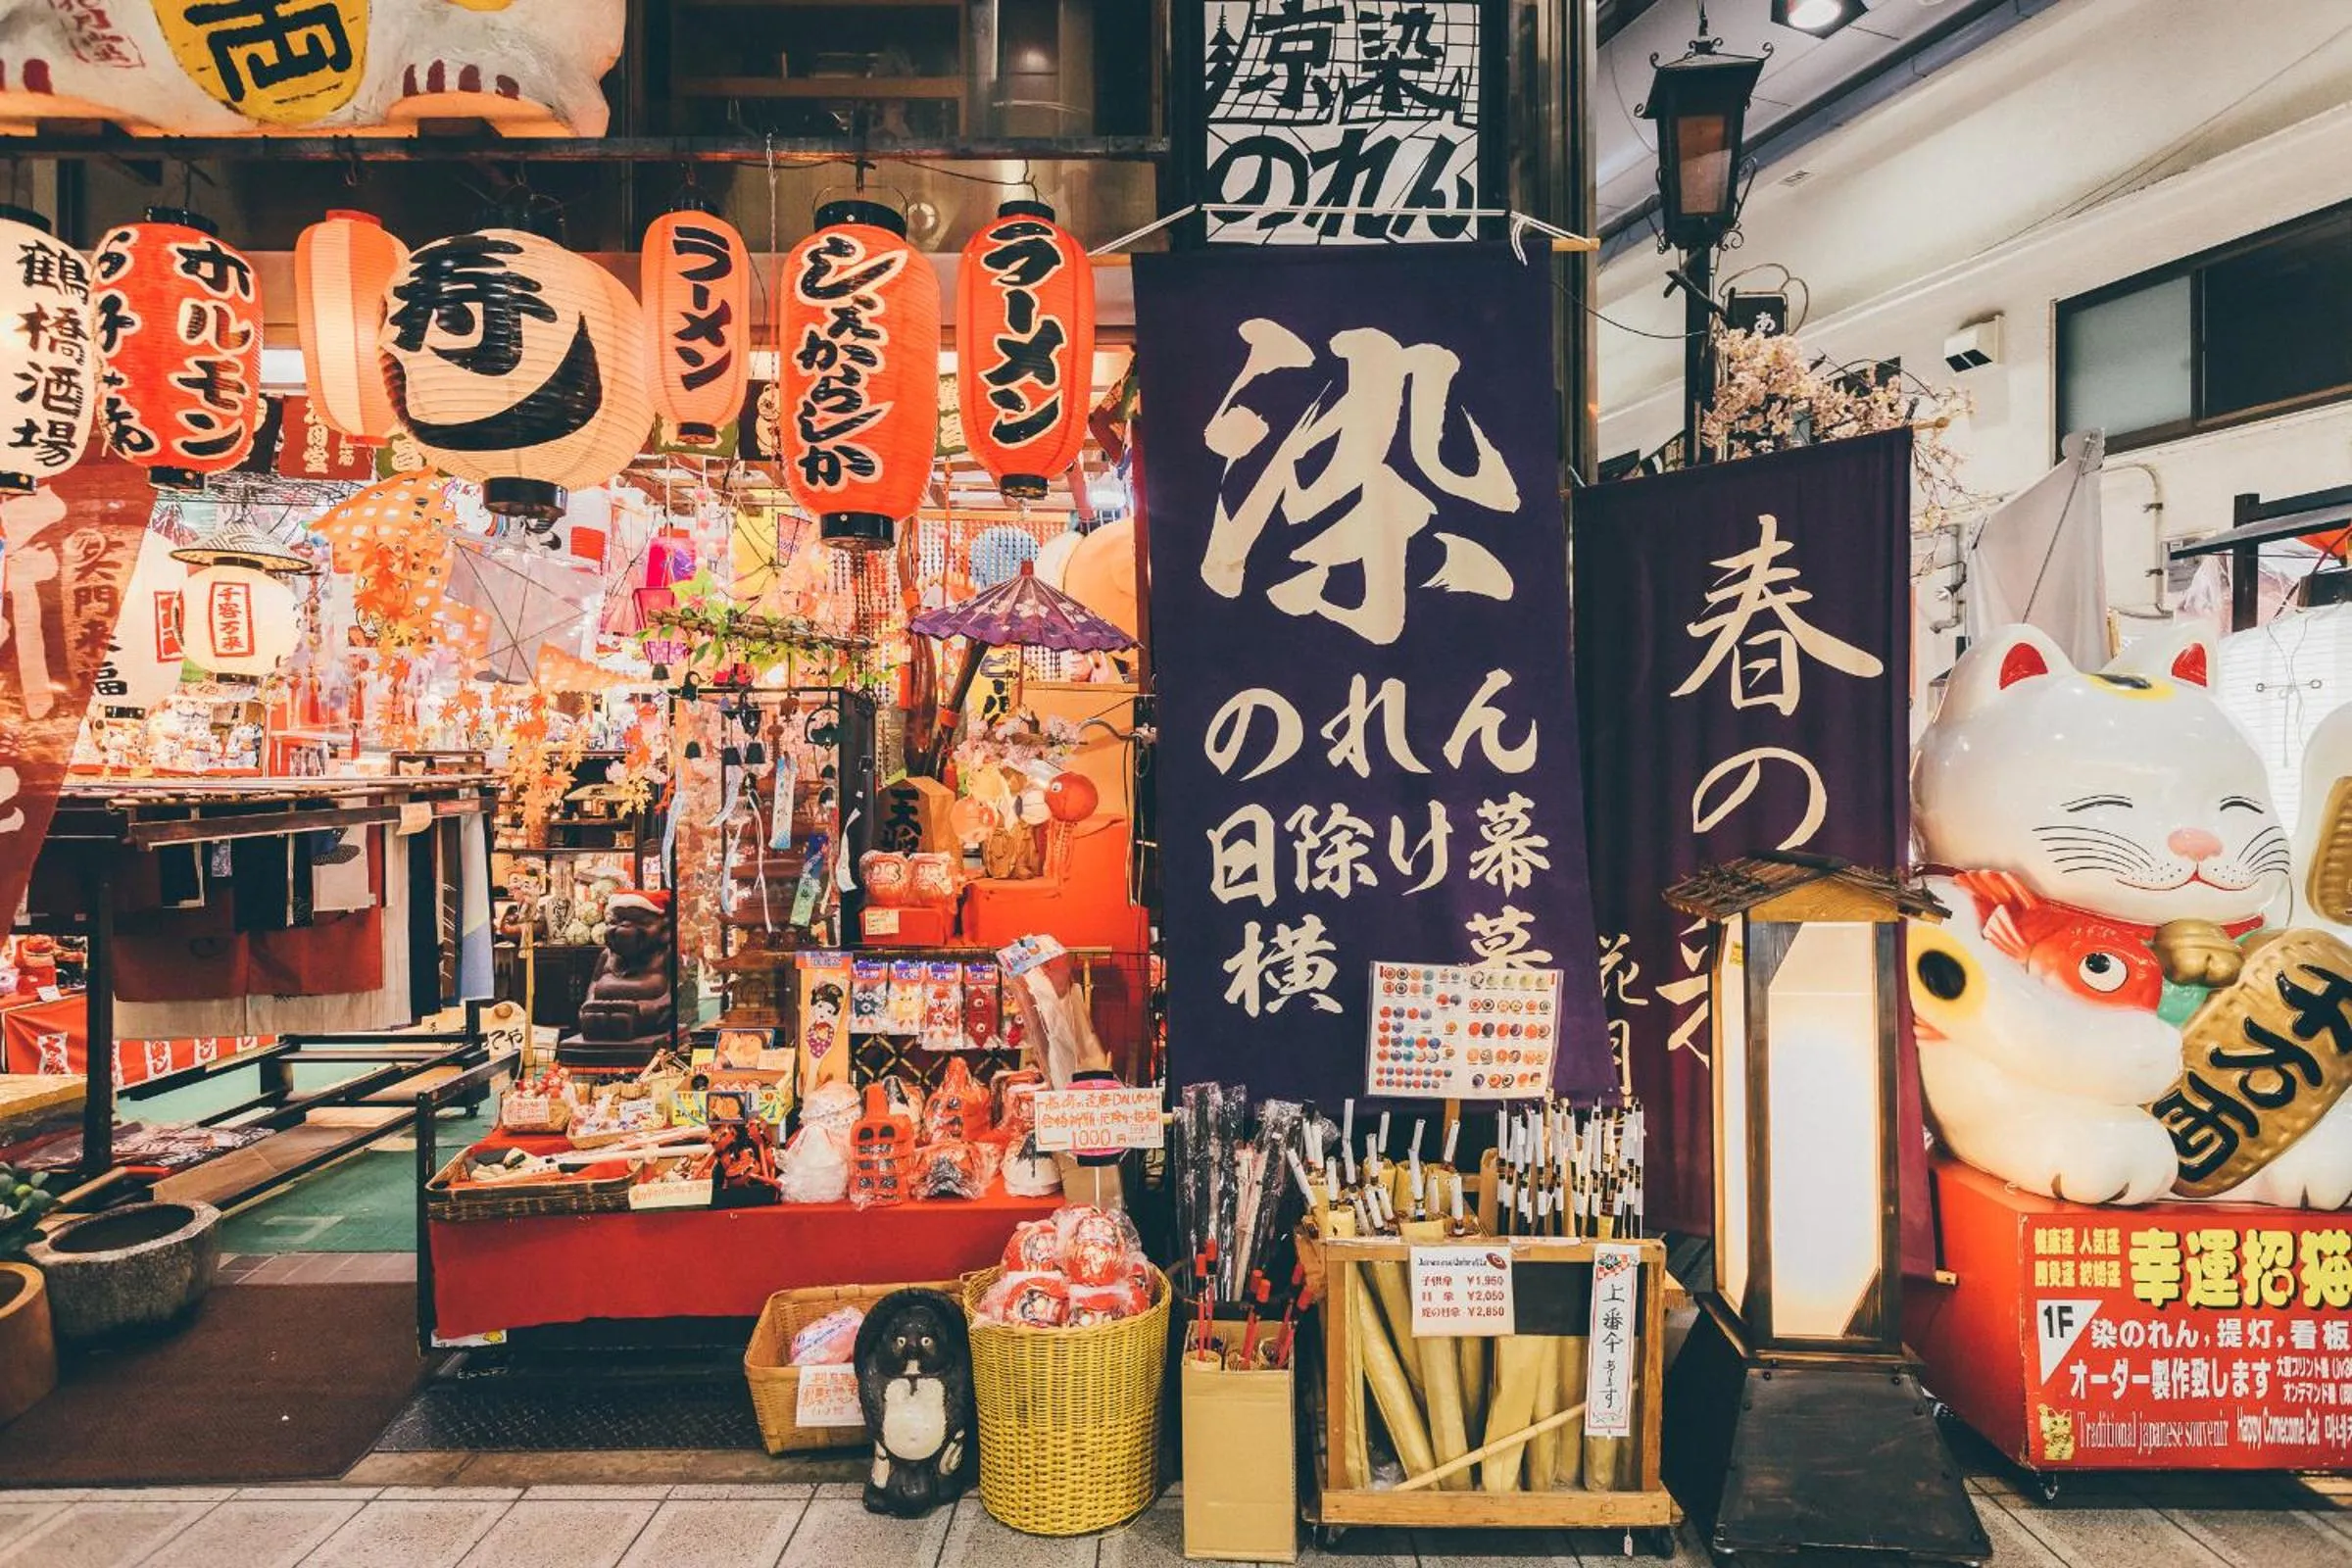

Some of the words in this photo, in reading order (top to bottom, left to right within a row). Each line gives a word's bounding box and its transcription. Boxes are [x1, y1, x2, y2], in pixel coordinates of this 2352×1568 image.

[1207, 129, 1474, 239] のれん
[8, 239, 90, 465] 鶴橋酒場
[175, 240, 252, 457] ホルモン
[378, 233, 603, 451] 寿し
[673, 226, 733, 391] ラーメン
[984, 222, 1063, 445] ラーメン
[1200, 318, 1521, 645] 染
[1204, 668, 1538, 781] のれん
[1206, 792, 1551, 906] 日除け幕
[2043, 1305, 2075, 1338] 1F
